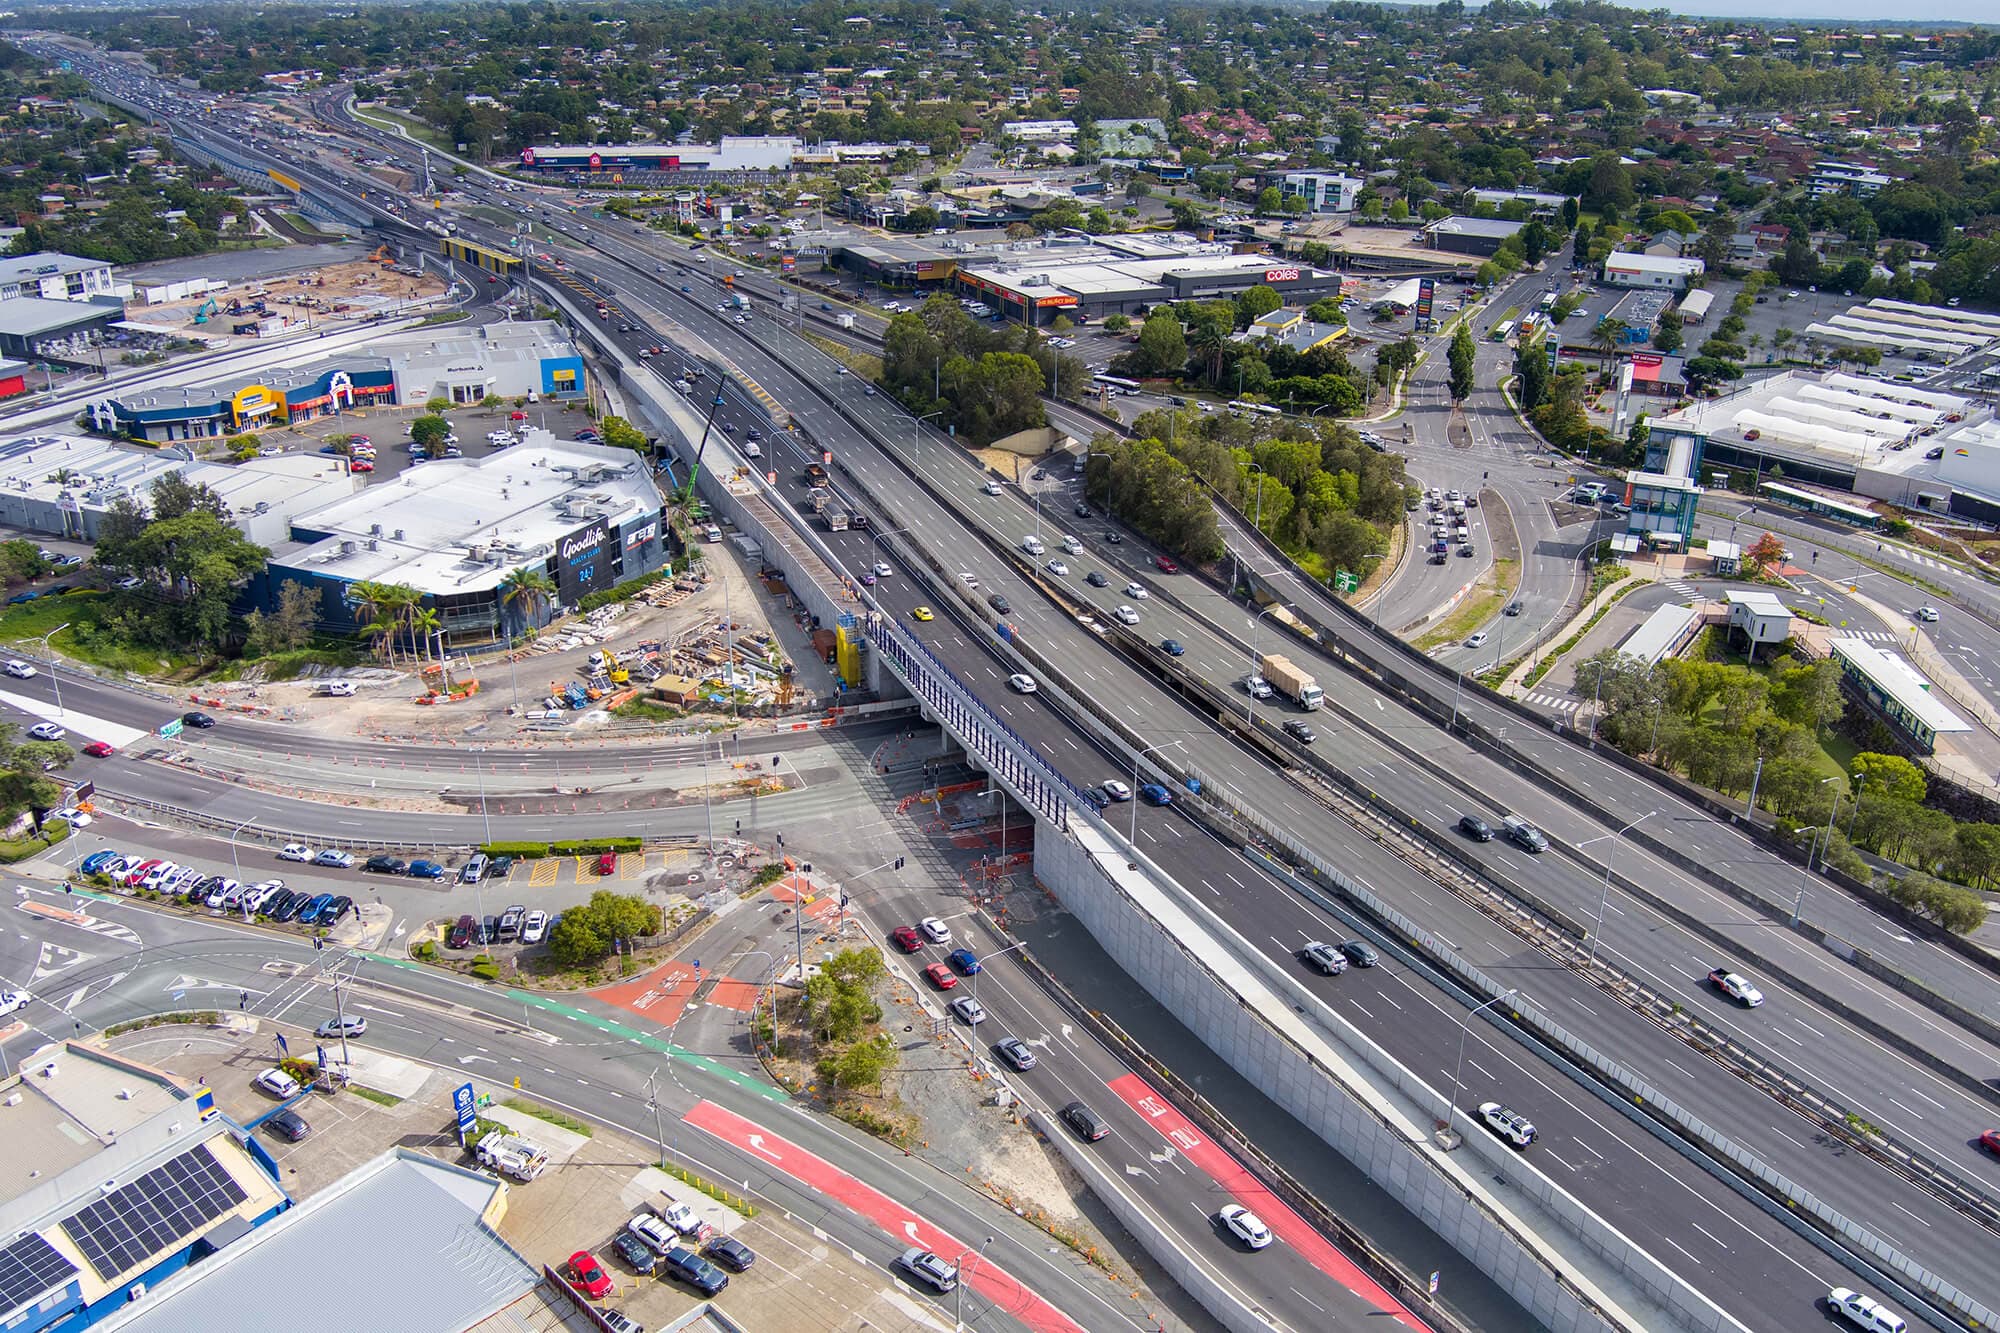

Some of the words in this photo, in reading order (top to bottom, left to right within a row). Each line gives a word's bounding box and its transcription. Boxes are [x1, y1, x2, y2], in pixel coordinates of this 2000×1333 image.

[1267, 269, 1298, 281] coles
[563, 526, 607, 560] Goodlife
[626, 522, 657, 545] arena
